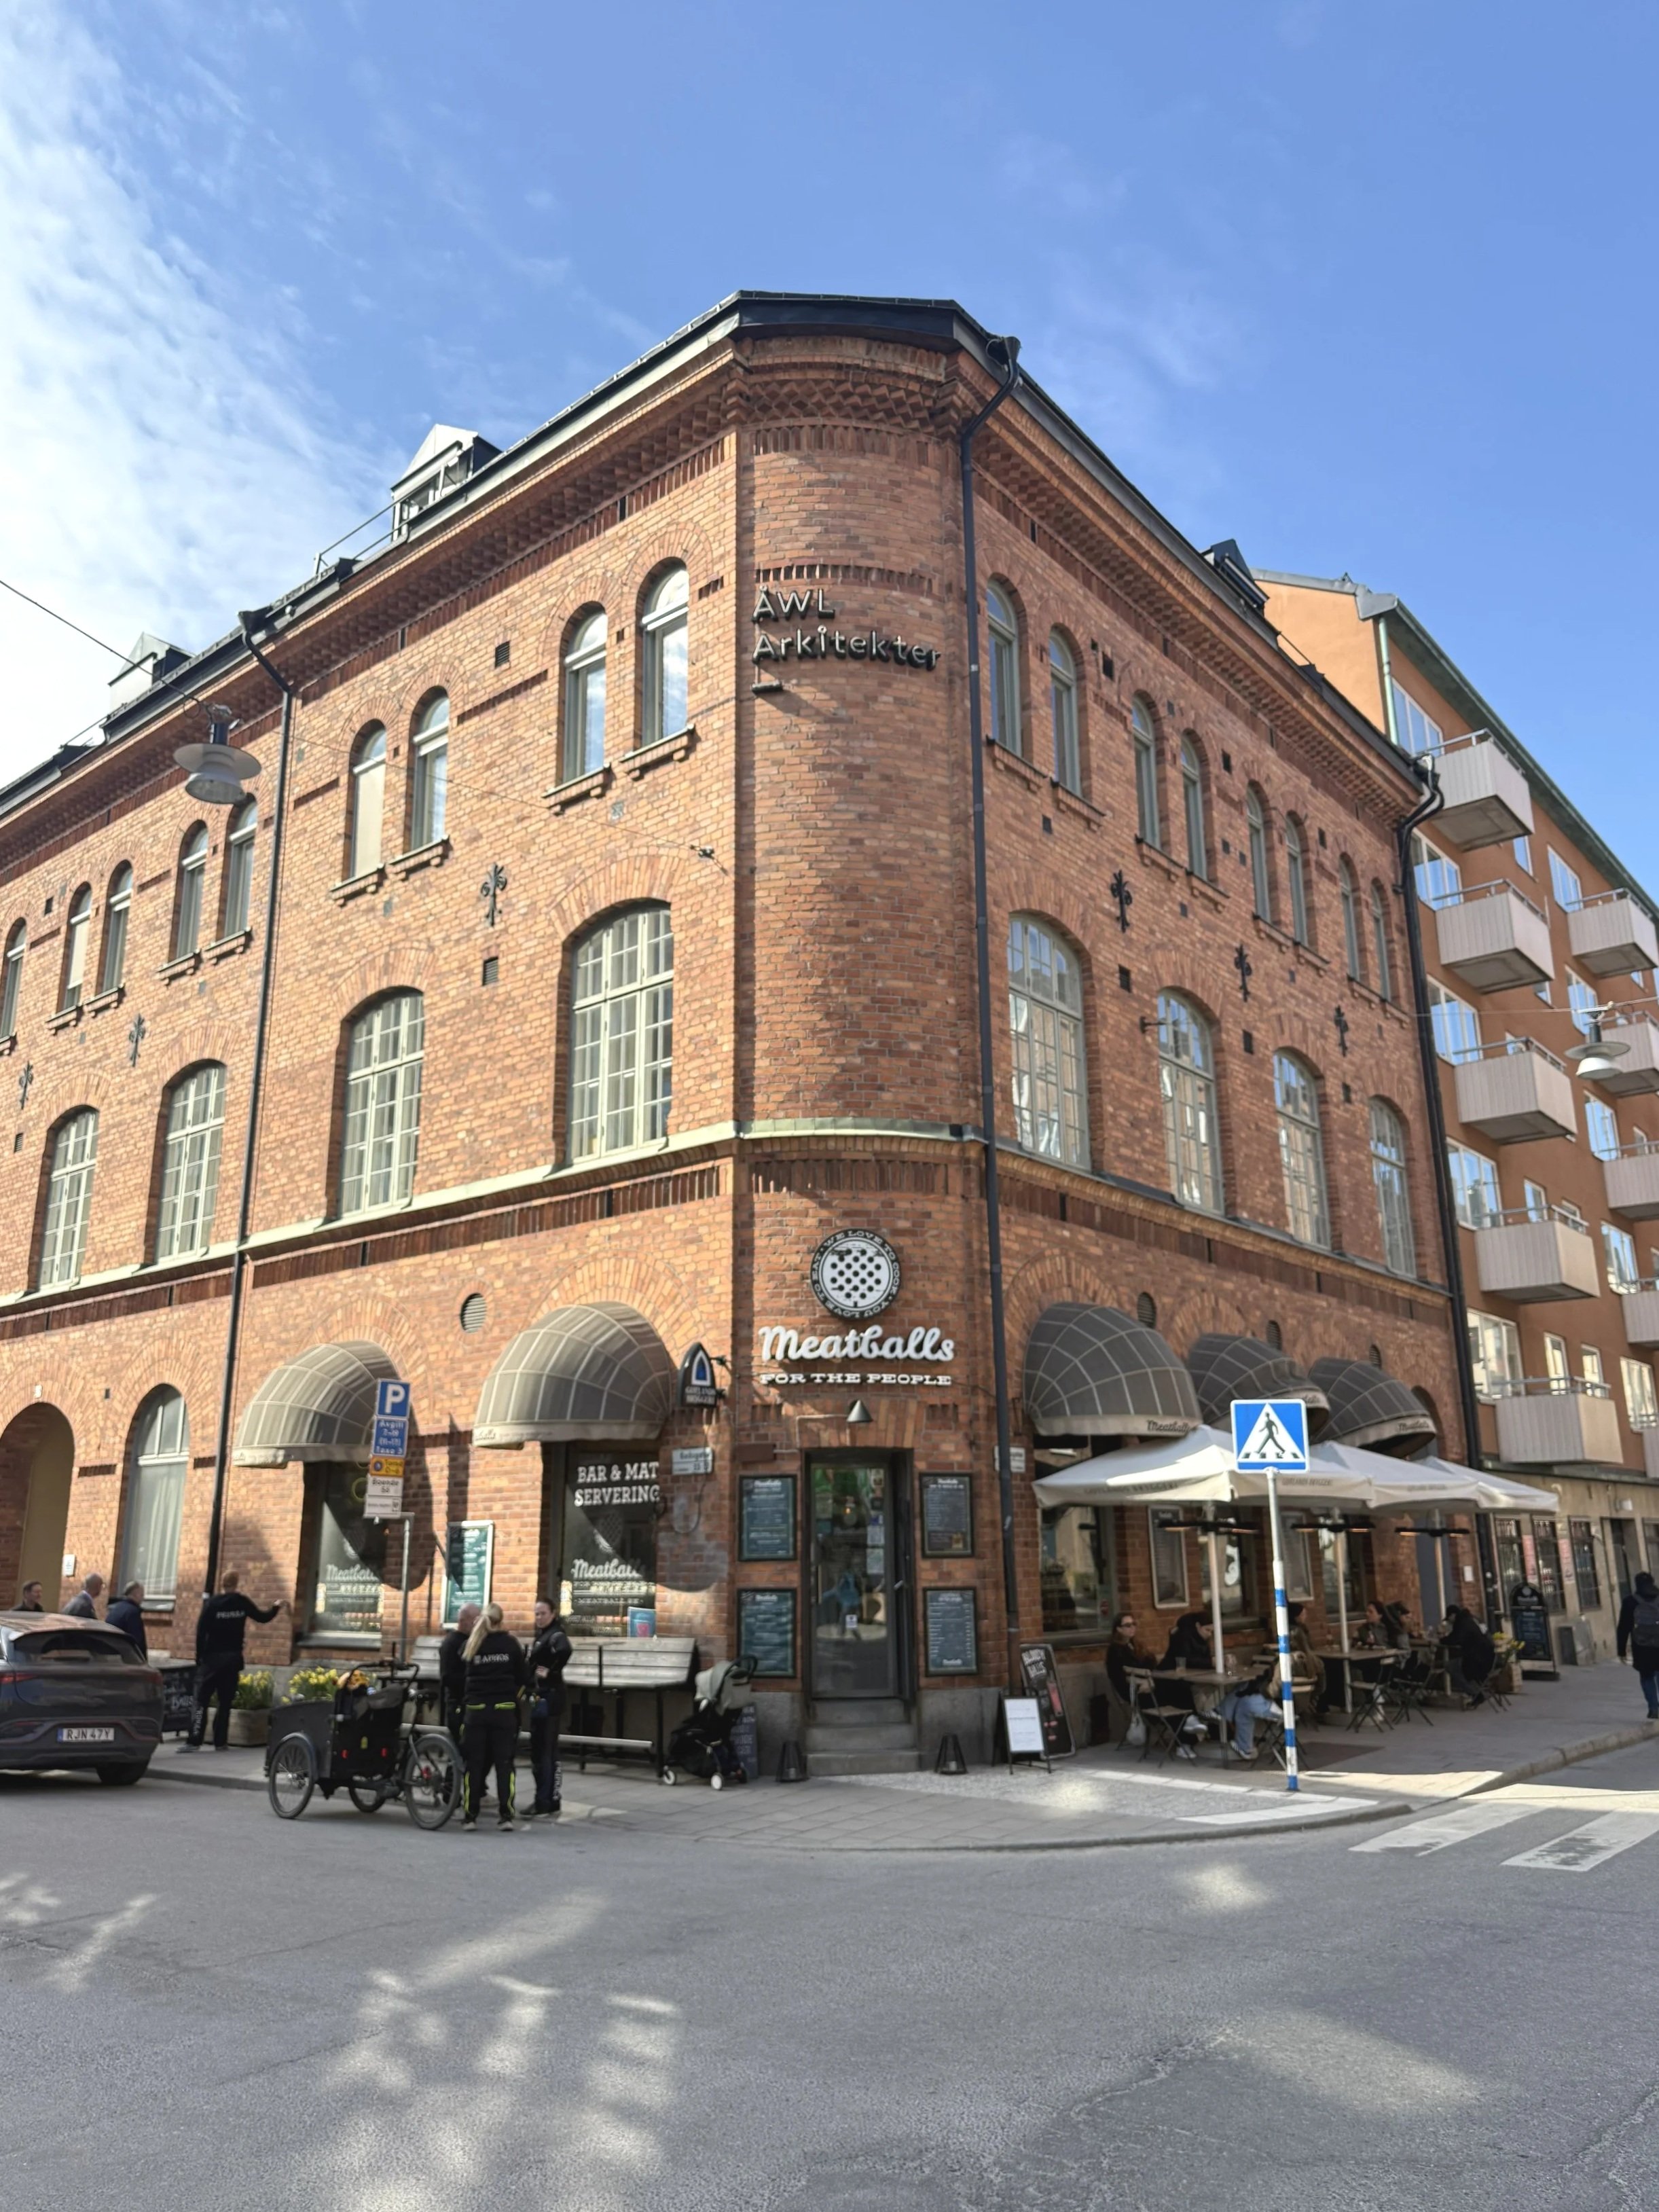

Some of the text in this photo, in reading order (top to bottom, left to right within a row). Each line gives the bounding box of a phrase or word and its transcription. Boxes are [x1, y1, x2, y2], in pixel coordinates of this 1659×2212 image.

[751, 585, 836, 623] ÅWL
[752, 625, 941, 671] Arkitekter
[812, 1253, 822, 1280] EAT
[824, 1231, 900, 1294] WE LOVE TO COOK
[825, 1301, 860, 1318] LOVE
[864, 1301, 889, 1317] YOU
[759, 1324, 954, 1362] Meatballs
[760, 1373, 951, 1385] FOR THE PEOPLE
[384, 1383, 405, 1413] P
[379, 1419, 404, 1429] Avgift
[577, 1461, 659, 1483] BAR & MAT
[574, 1484, 660, 1507] SERVERING
